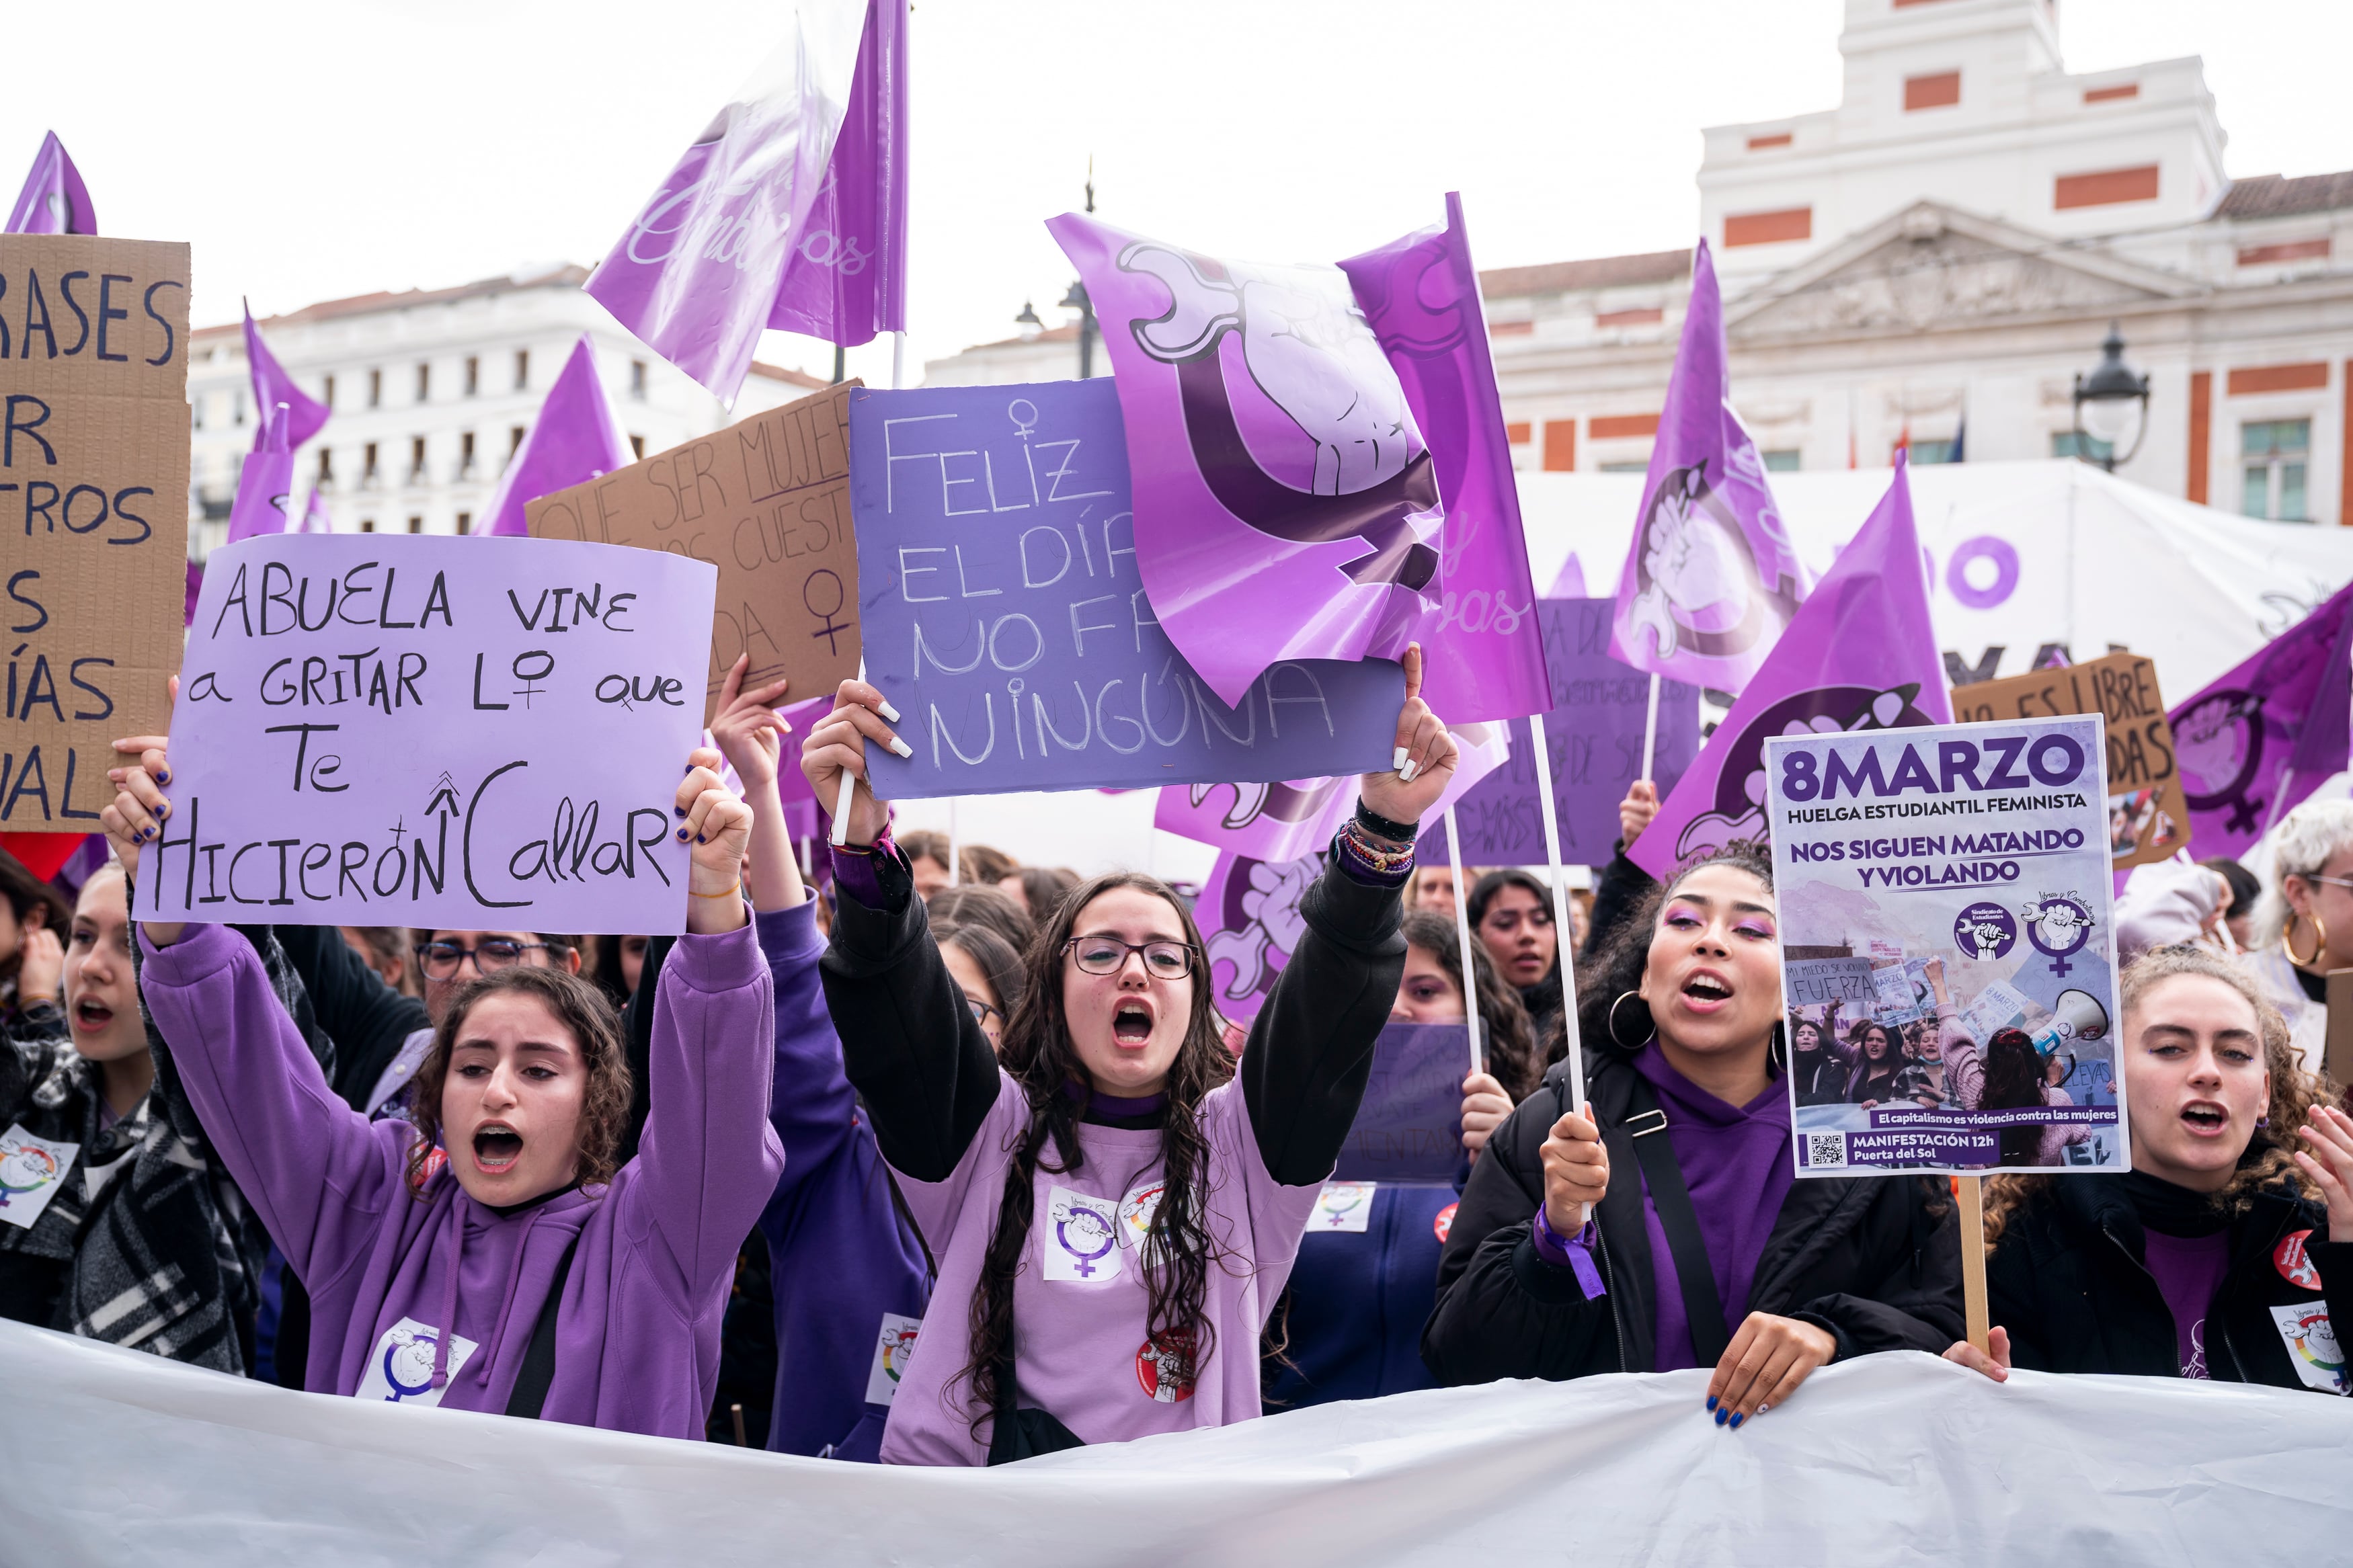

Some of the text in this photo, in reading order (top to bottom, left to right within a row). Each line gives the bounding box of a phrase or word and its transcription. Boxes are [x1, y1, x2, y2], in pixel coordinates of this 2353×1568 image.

[647, 441, 727, 530] SER
[733, 485, 847, 572] CUEST
[898, 546, 1004, 602] EL
[212, 561, 637, 640] ABUELA VINE
[708, 602, 781, 678] DA
[914, 612, 1046, 682] NO
[260, 647, 427, 714] GRITAR
[1787, 793, 2087, 824] HUELGA ESTUDIANTIL FEMINISTA
[1790, 827, 2085, 864] NOS SIGUEN MATANDO
[1857, 860, 2021, 888] Y VIOLANDO
[1786, 968, 1798, 978] MI
[1801, 964, 1829, 977] MIEDO
[1831, 964, 1841, 973] SE
[1794, 975, 1876, 1002] FUERZA
[1878, 1109, 2117, 1125] El capitalismo es violencia contra las mujeres
[1853, 1132, 1995, 1148] MANIFESTACIÓN 12h
[1854, 1147, 1936, 1161] Puerta del Sol
